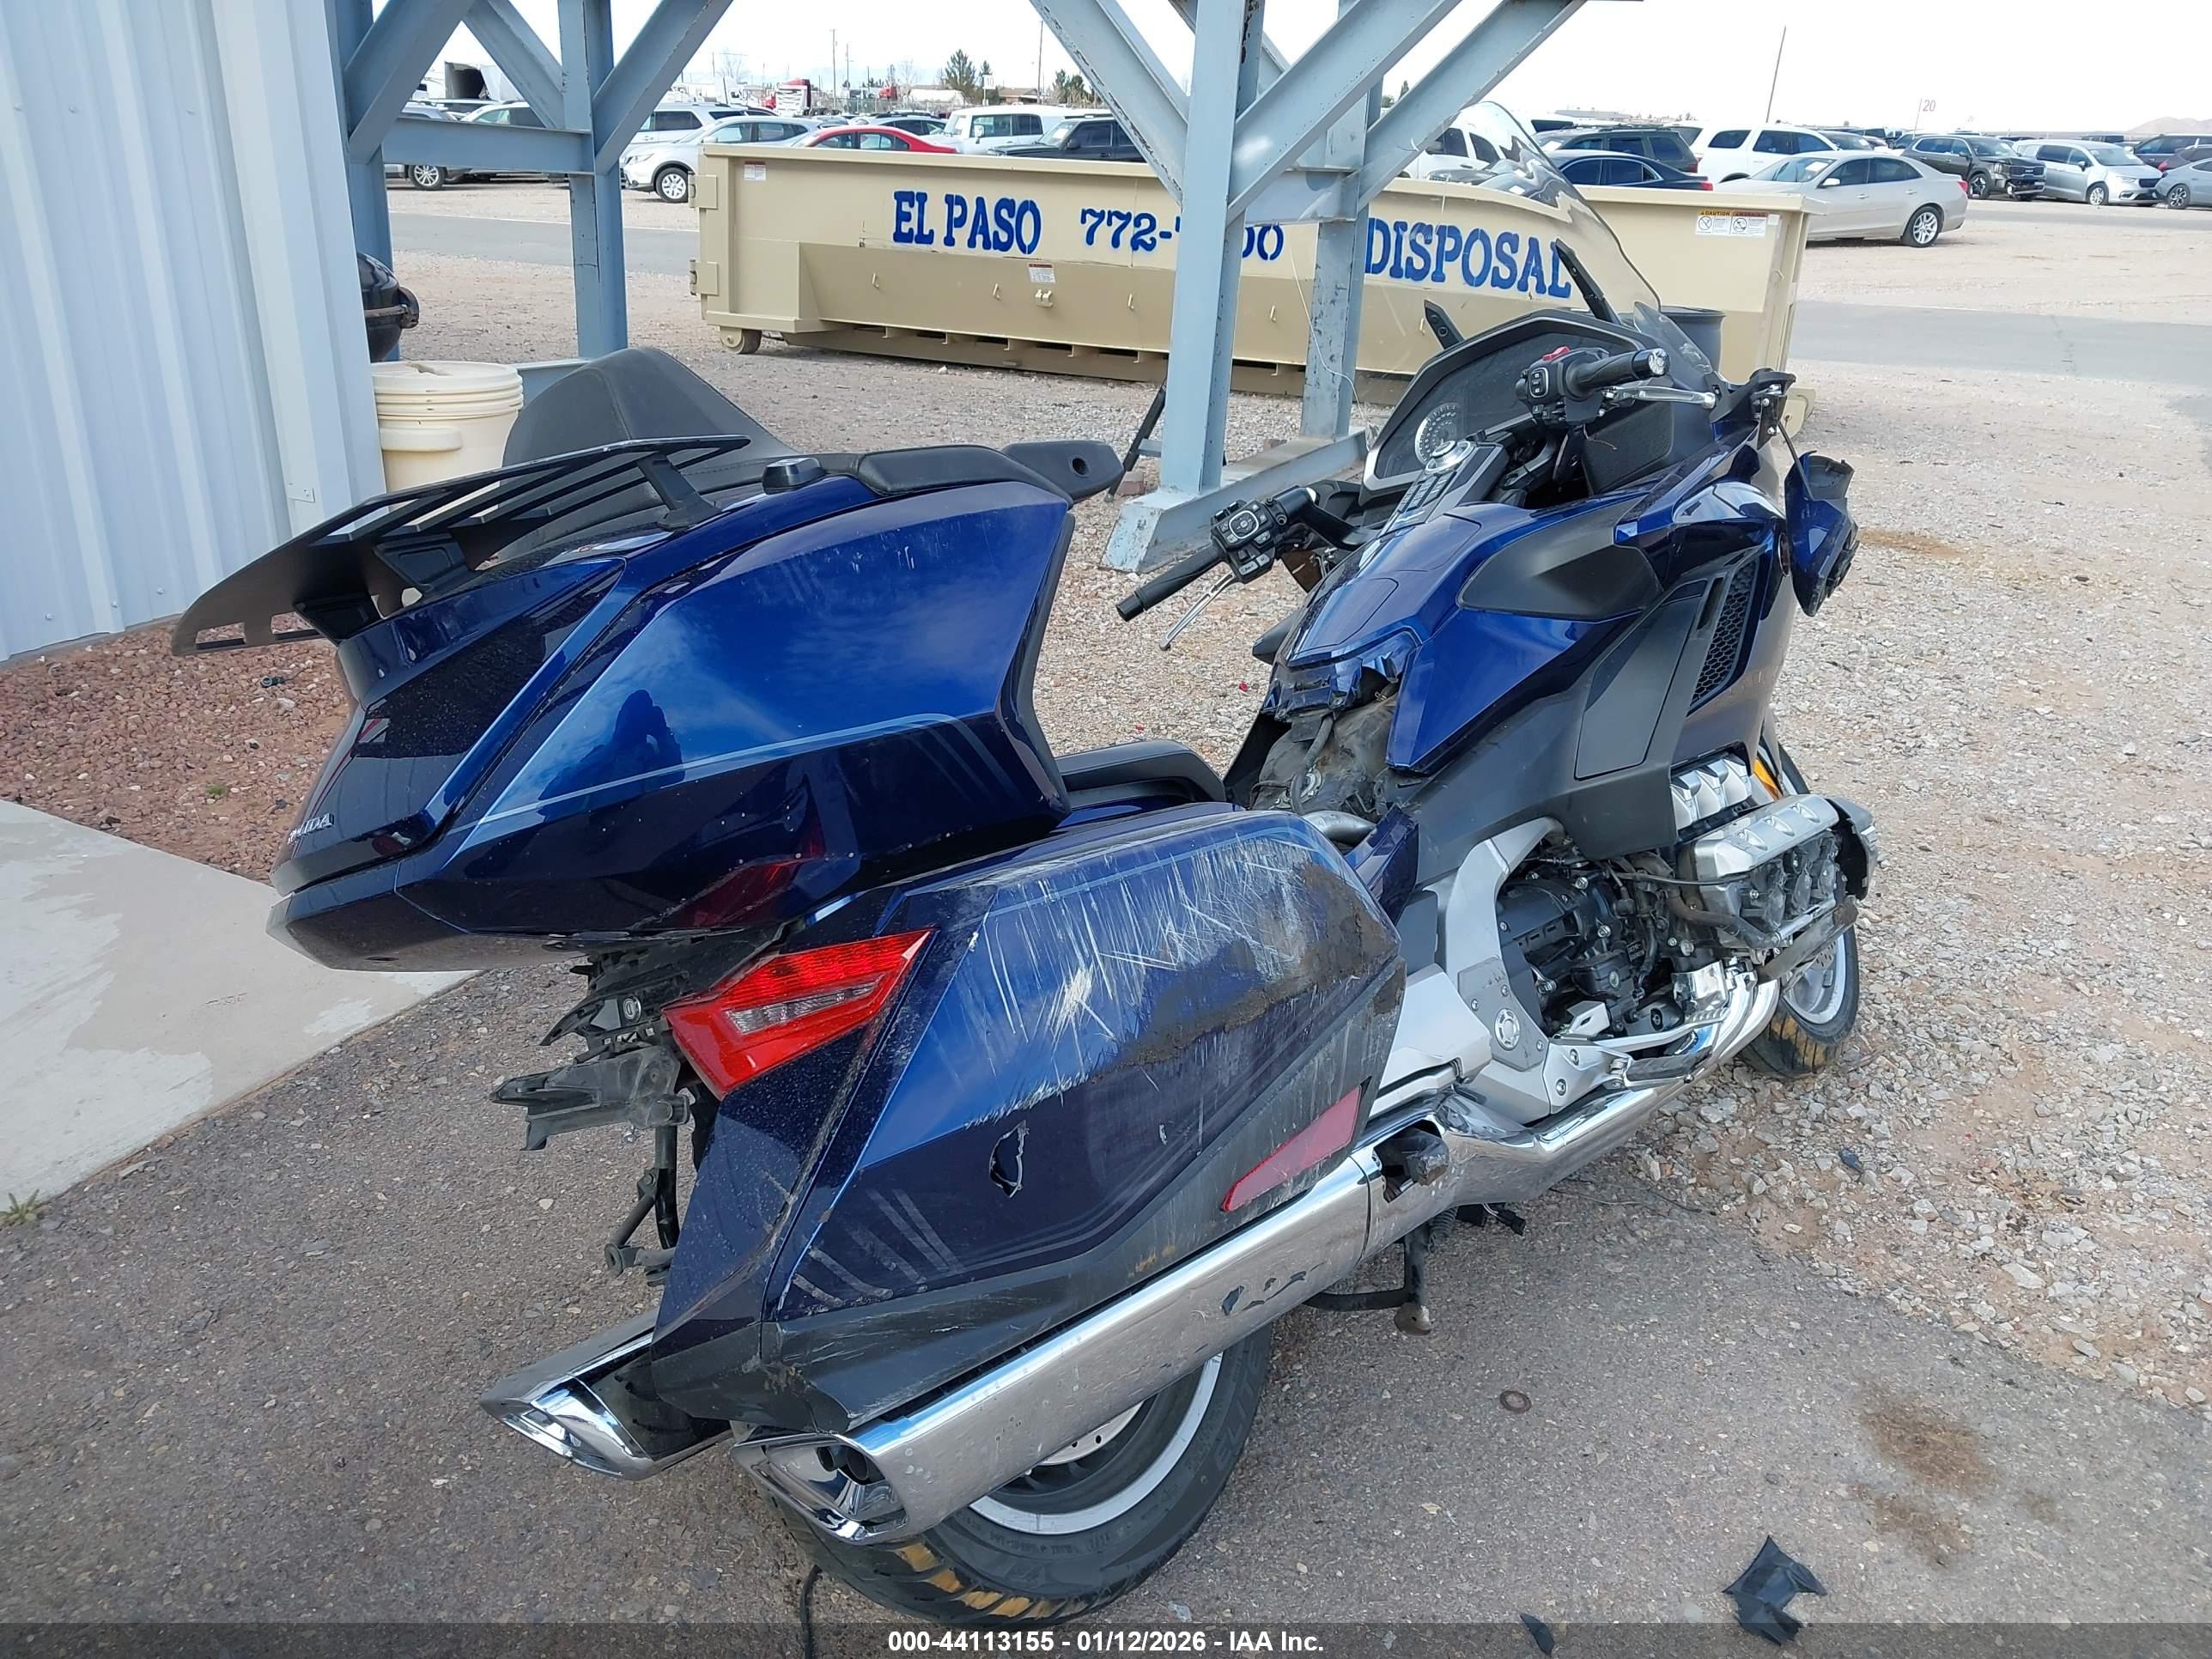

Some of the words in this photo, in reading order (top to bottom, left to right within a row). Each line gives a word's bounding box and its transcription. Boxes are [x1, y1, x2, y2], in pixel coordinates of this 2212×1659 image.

[1923, 99, 1936, 112] 20
[893, 191, 934, 245] EL
[944, 193, 1042, 255] PASO
[1365, 217, 1571, 298] DISPOSAL
